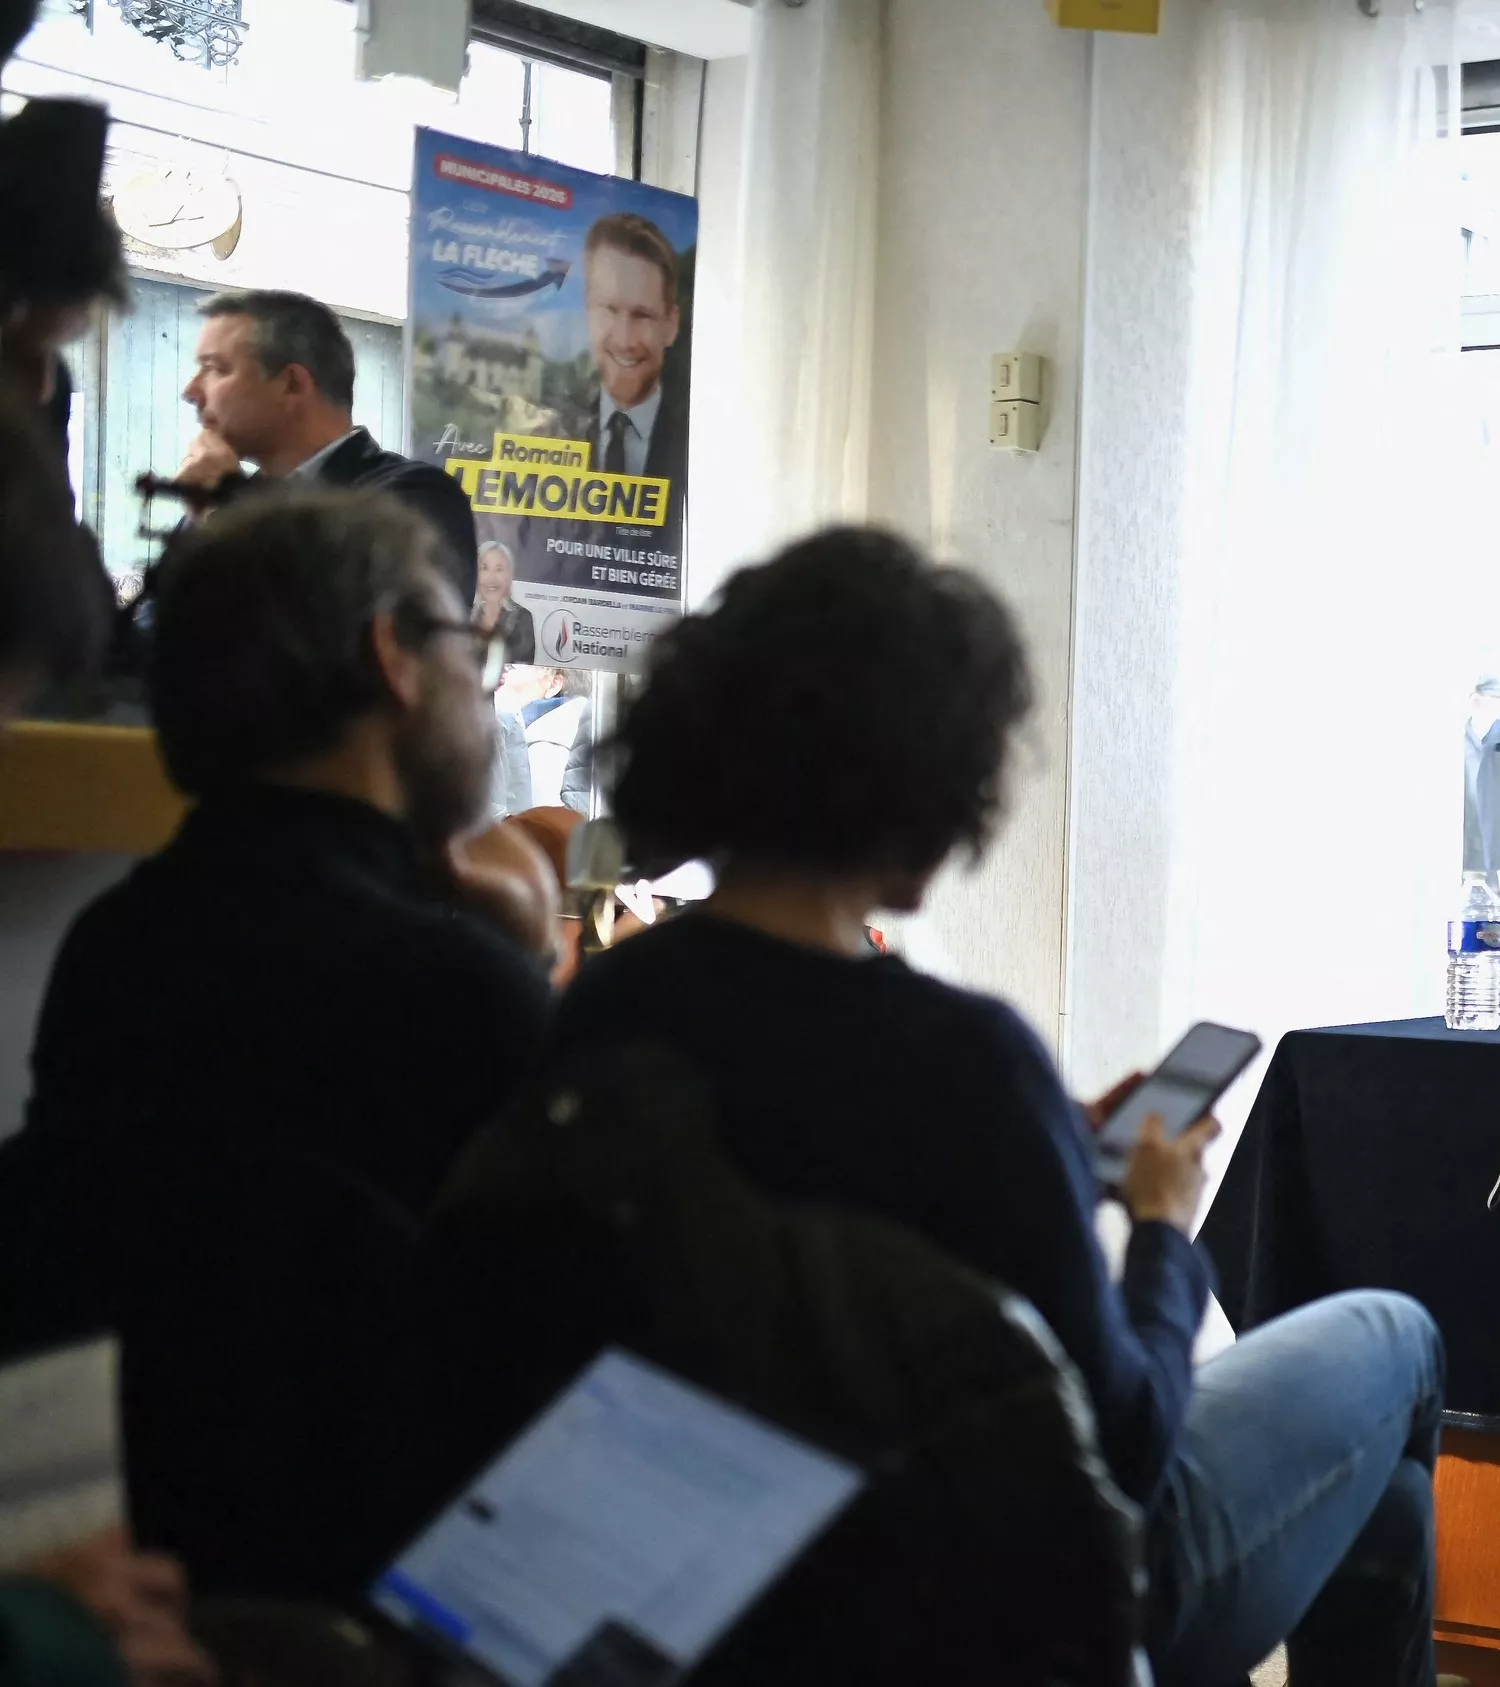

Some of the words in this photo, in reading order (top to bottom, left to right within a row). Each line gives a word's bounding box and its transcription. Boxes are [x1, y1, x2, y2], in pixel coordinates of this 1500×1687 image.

[433, 423, 488, 454] Avec
[499, 439, 582, 468] Romain
[546, 538, 584, 557] POUR
[585, 543, 612, 561] UNE
[612, 547, 646, 565] VILLE
[646, 551, 678, 570] SÛRE
[591, 566, 607, 581] ET
[608, 567, 638, 585] BIEN
[638, 570, 677, 590] GÉRÉE
[572, 640, 629, 658] National
